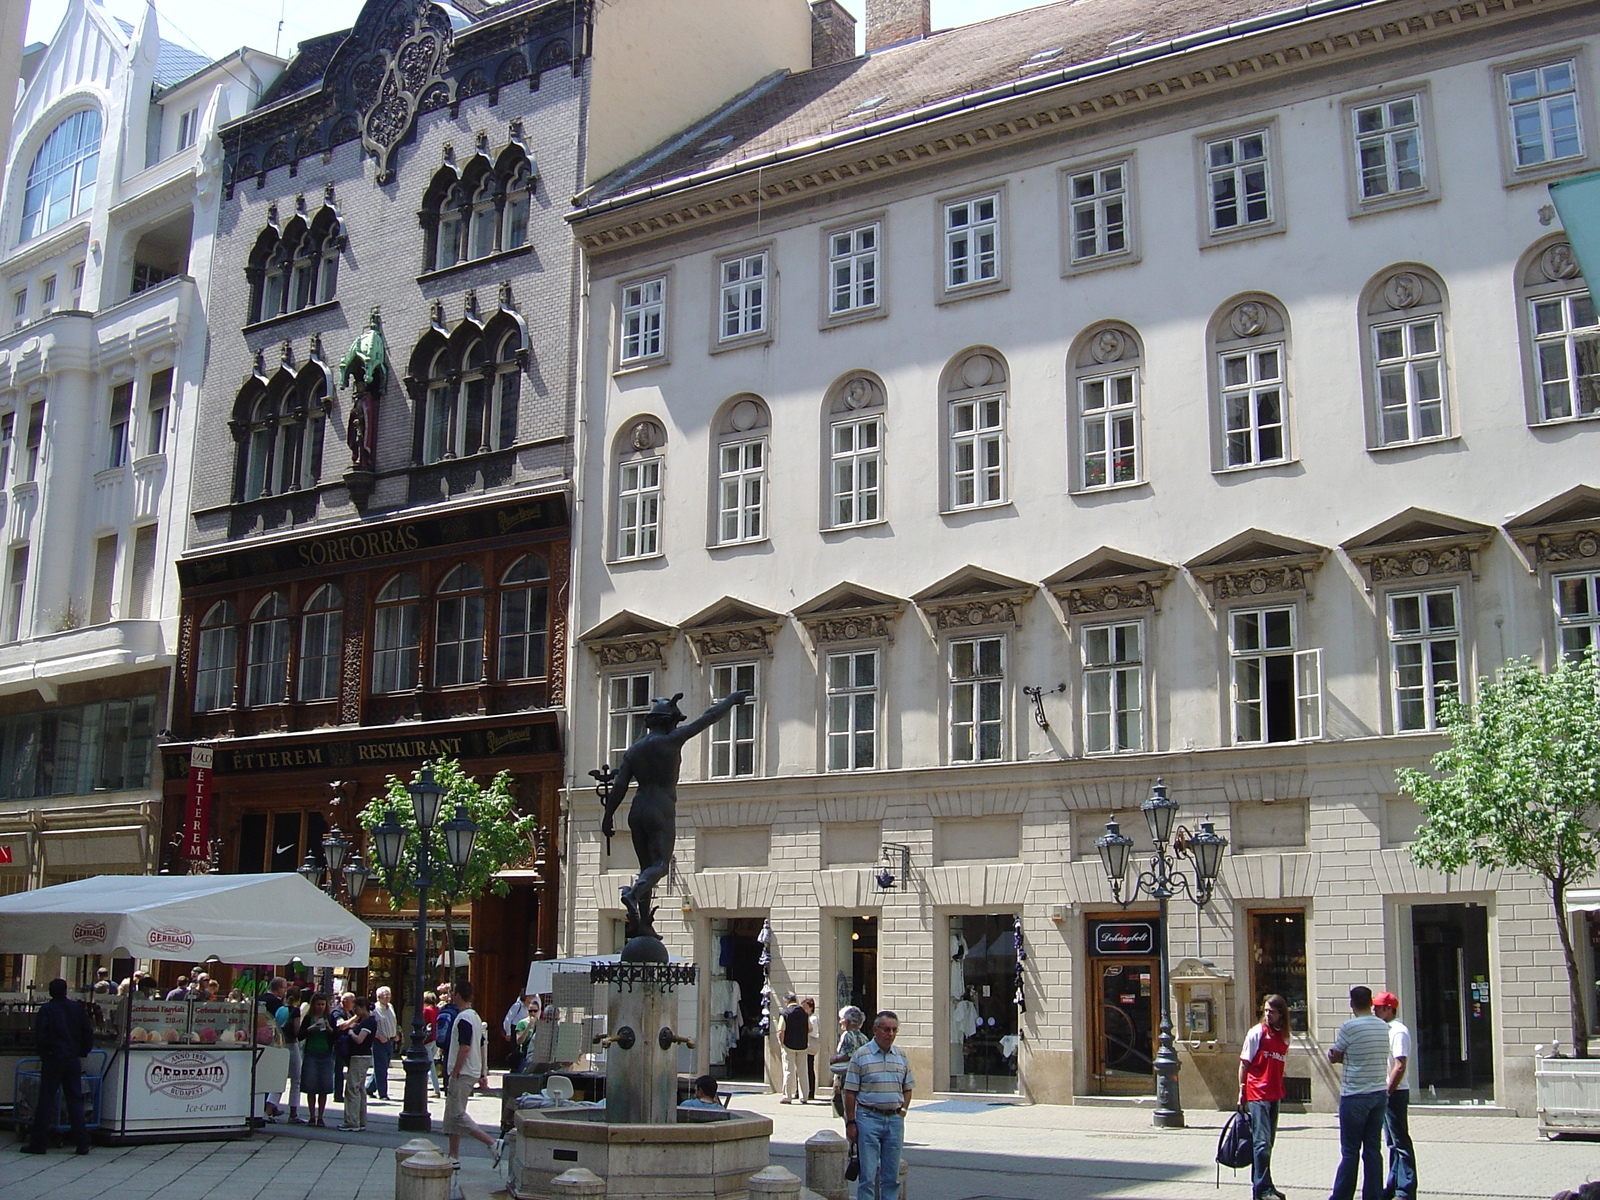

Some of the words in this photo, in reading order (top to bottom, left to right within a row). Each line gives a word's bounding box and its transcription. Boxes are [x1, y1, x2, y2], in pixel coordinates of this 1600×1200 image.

[298, 525, 418, 567] SÖRFORRÁS
[357, 737, 461, 760] RESTAURANT
[233, 750, 322, 769] ÉTTEREM
[190, 769, 205, 855] ÉTTEREM
[150, 932, 192, 945] GERBEAUD
[317, 942, 353, 952] GERBEAUD
[171, 1054, 190, 1063] ANNO
[151, 1065, 224, 1085] GERBEAUD
[170, 1087, 204, 1096] BUDAPEST
[185, 1103, 227, 1113] Ice-Cream
